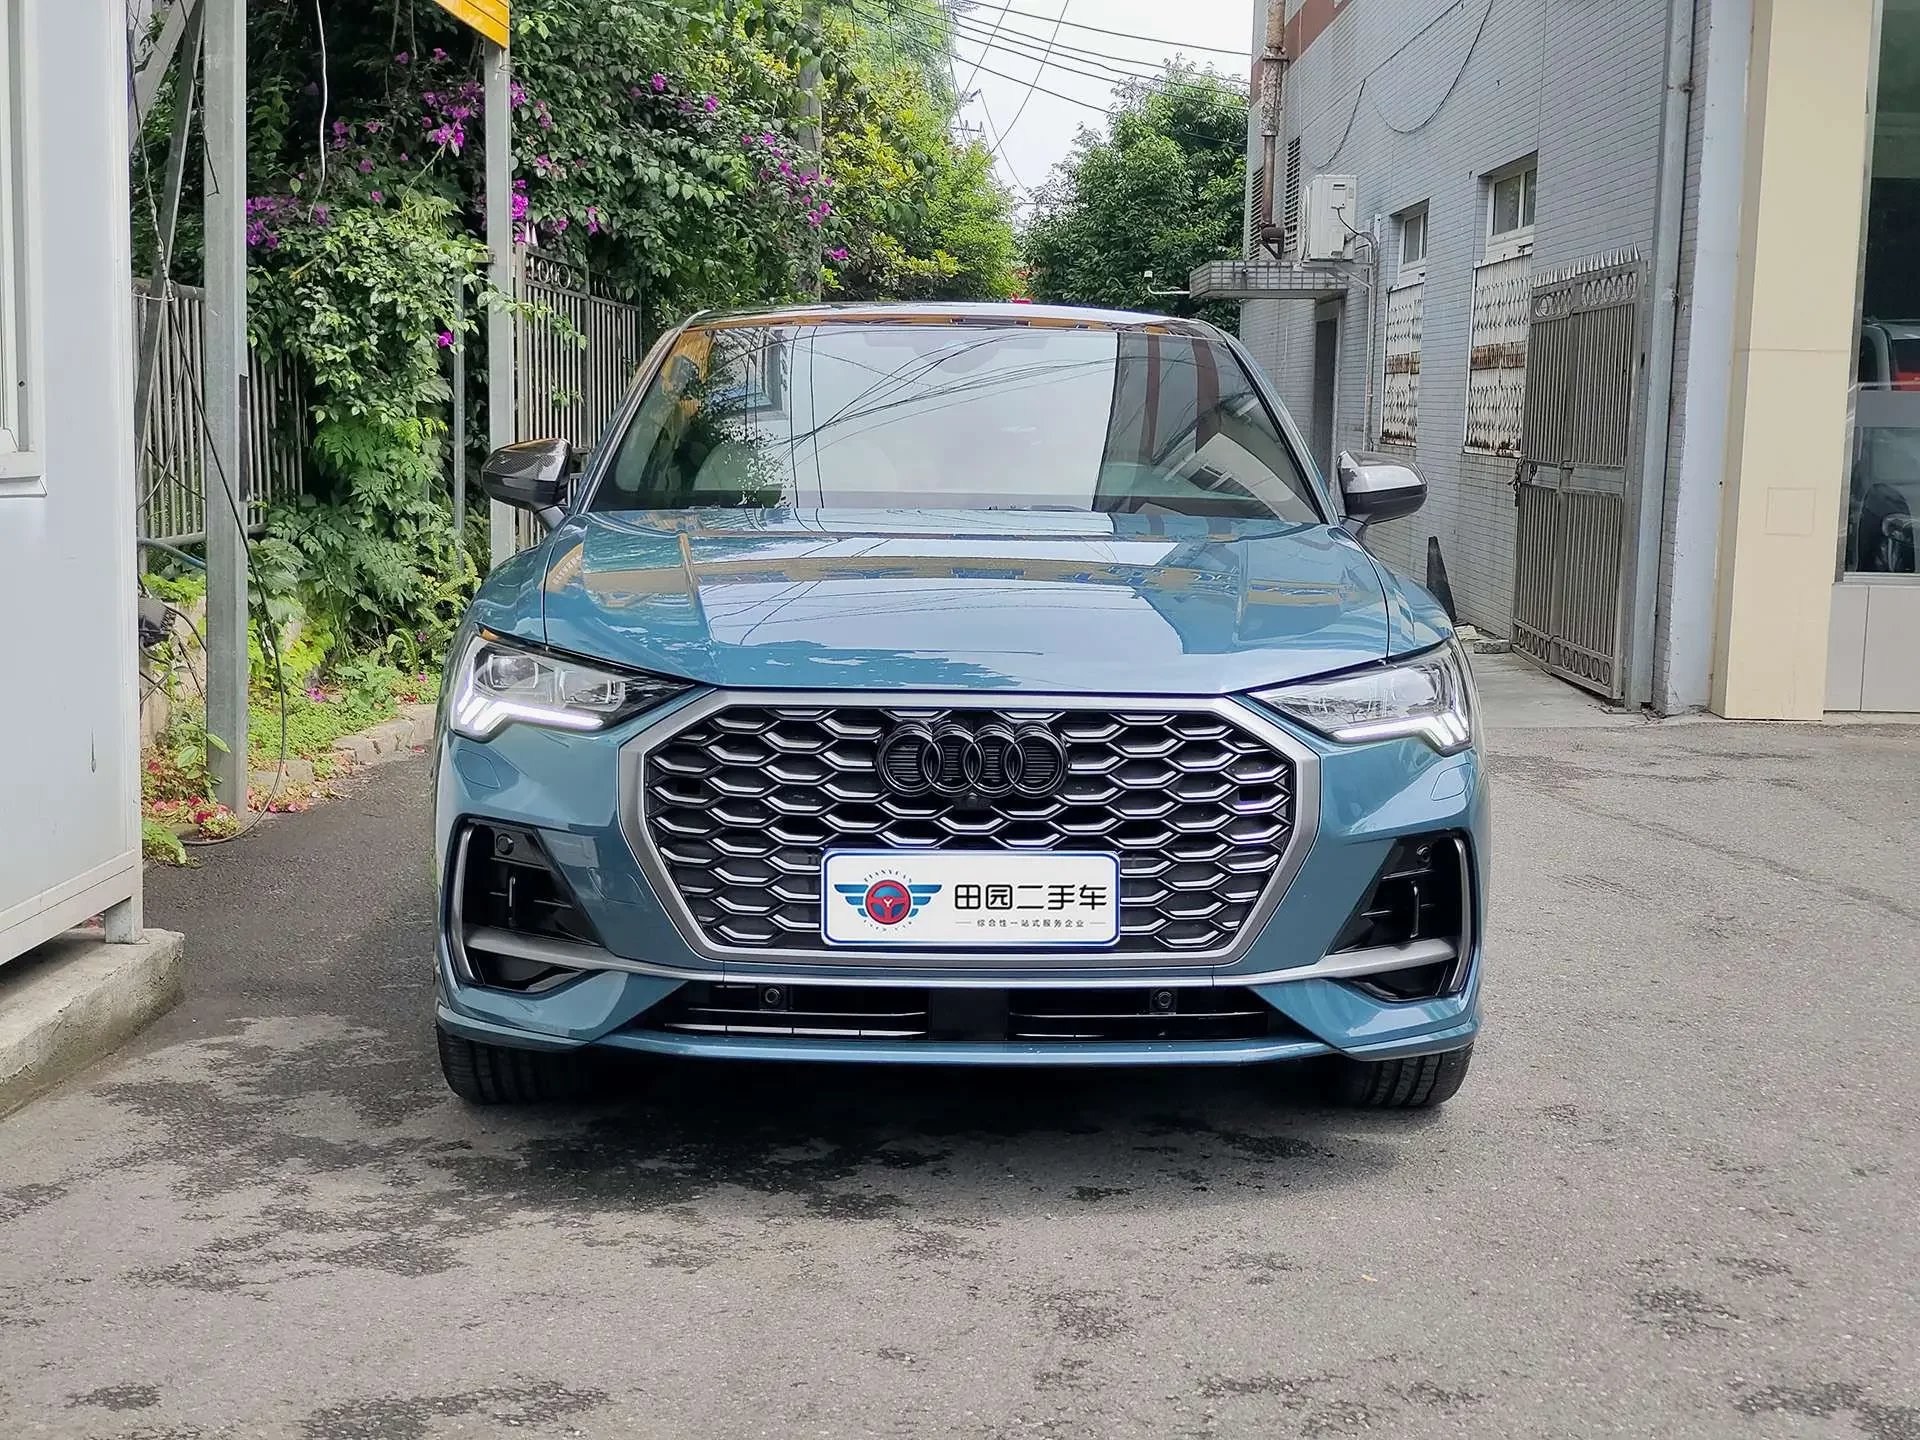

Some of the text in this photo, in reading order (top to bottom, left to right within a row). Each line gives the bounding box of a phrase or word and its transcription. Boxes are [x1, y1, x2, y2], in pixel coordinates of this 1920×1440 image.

[954, 884, 1107, 911] 田园二手车
